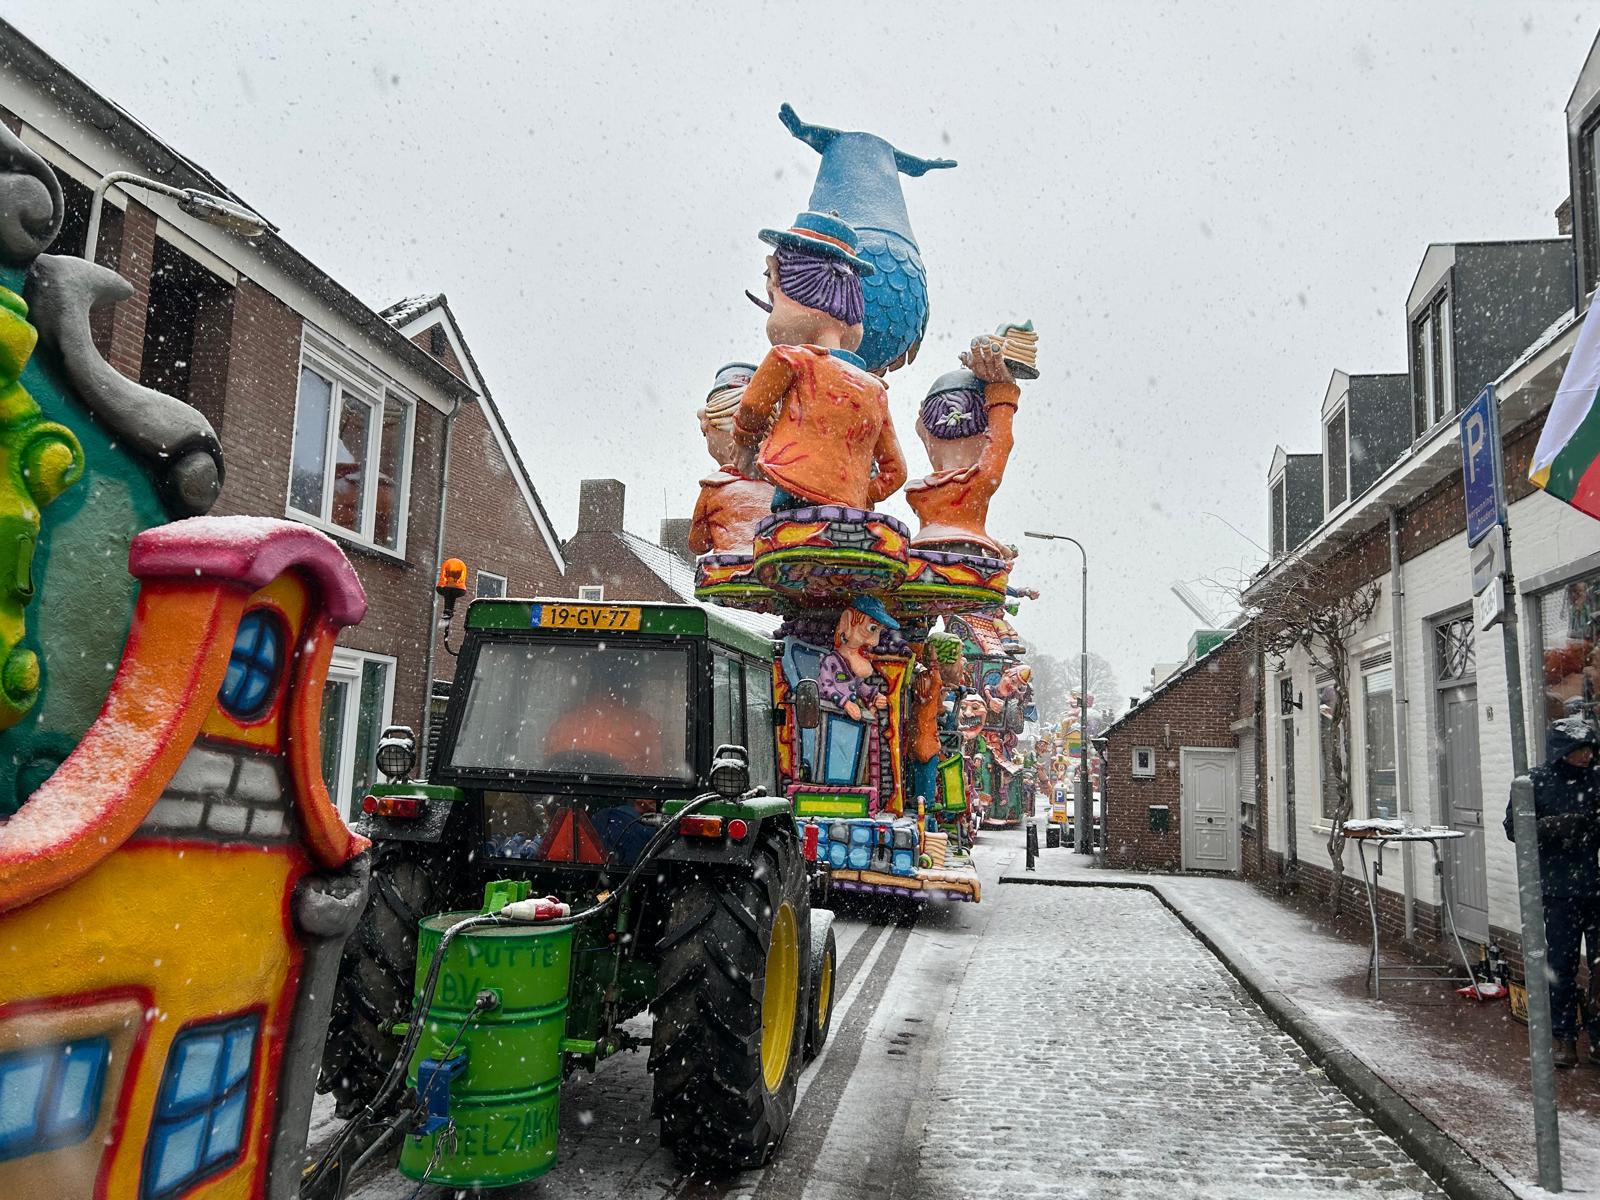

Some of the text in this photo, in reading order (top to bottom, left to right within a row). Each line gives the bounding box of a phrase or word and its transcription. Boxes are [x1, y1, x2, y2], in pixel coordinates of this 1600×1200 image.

[1466, 411, 1485, 484] P
[550, 608, 630, 627] 19-GV-77
[1056, 790, 1063, 802] P
[467, 942, 554, 968] PUTTE
